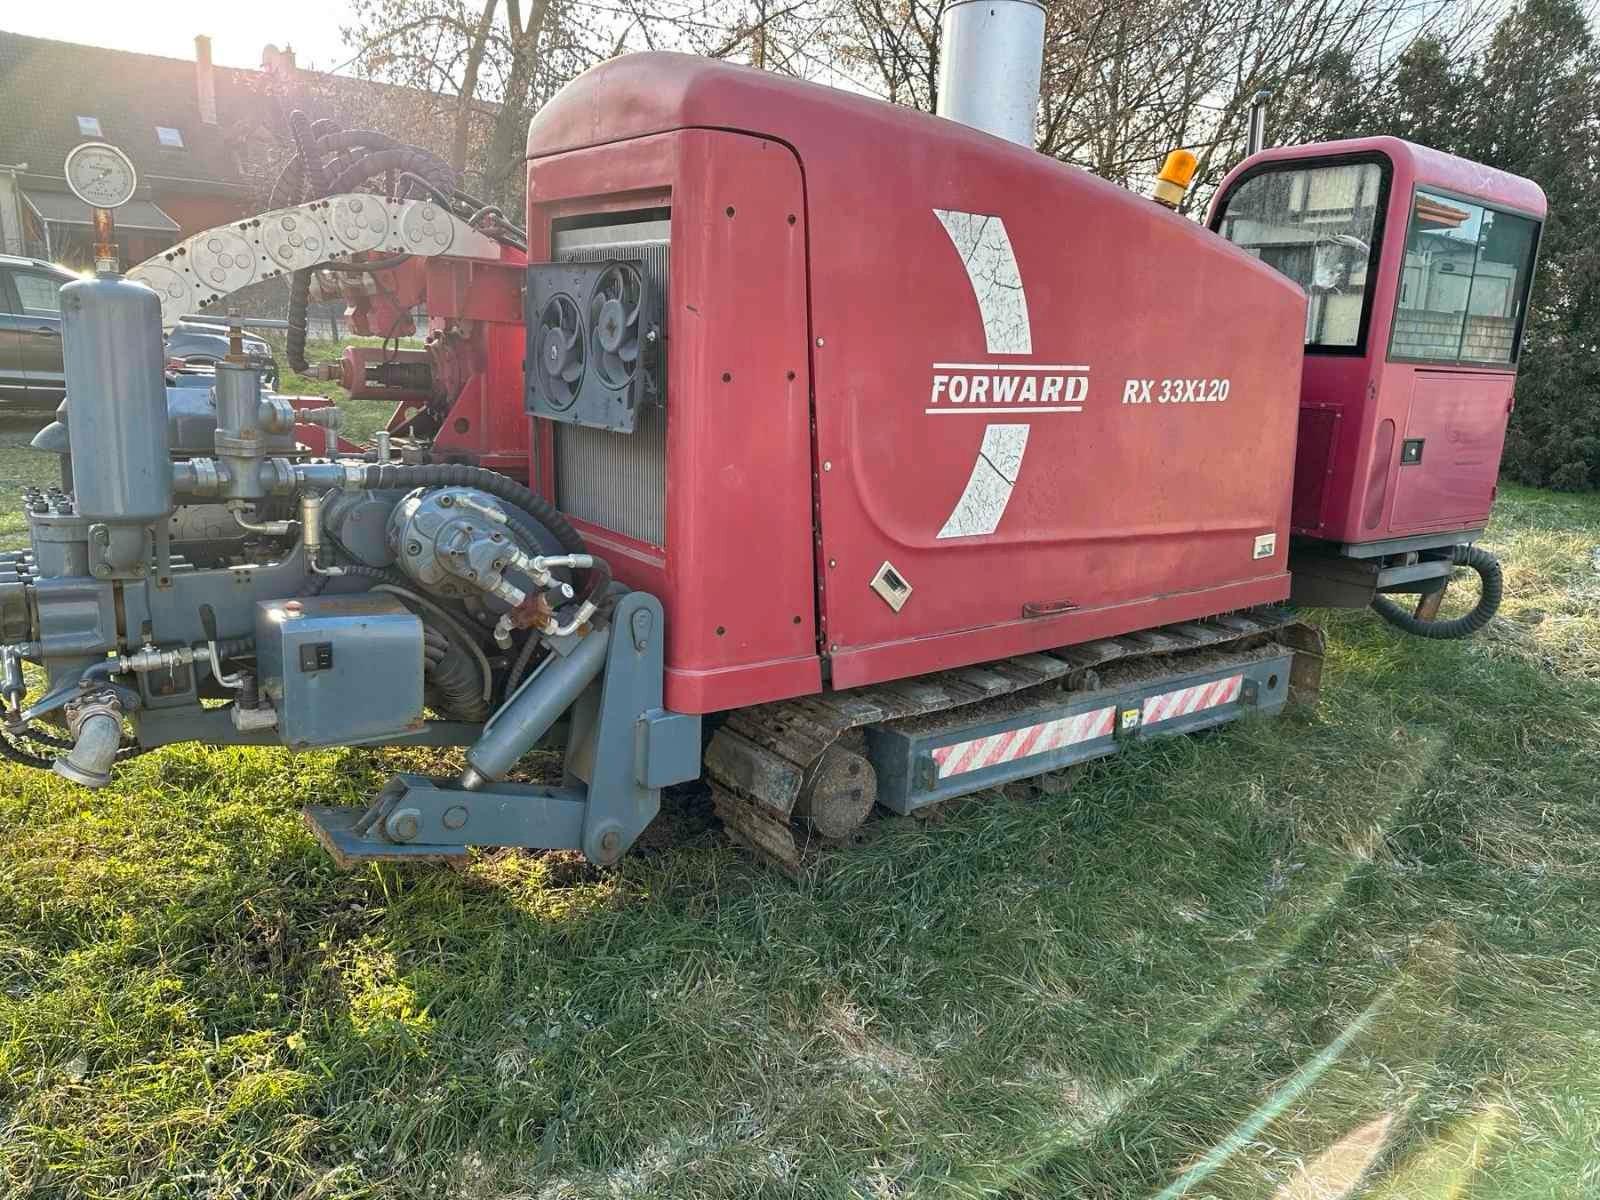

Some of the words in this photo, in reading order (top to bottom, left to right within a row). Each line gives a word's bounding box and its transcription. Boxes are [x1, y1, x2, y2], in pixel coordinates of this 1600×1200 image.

[931, 375, 1089, 403] FORWARD
[1122, 380, 1155, 404] RX
[1158, 379, 1230, 403] 33X120
